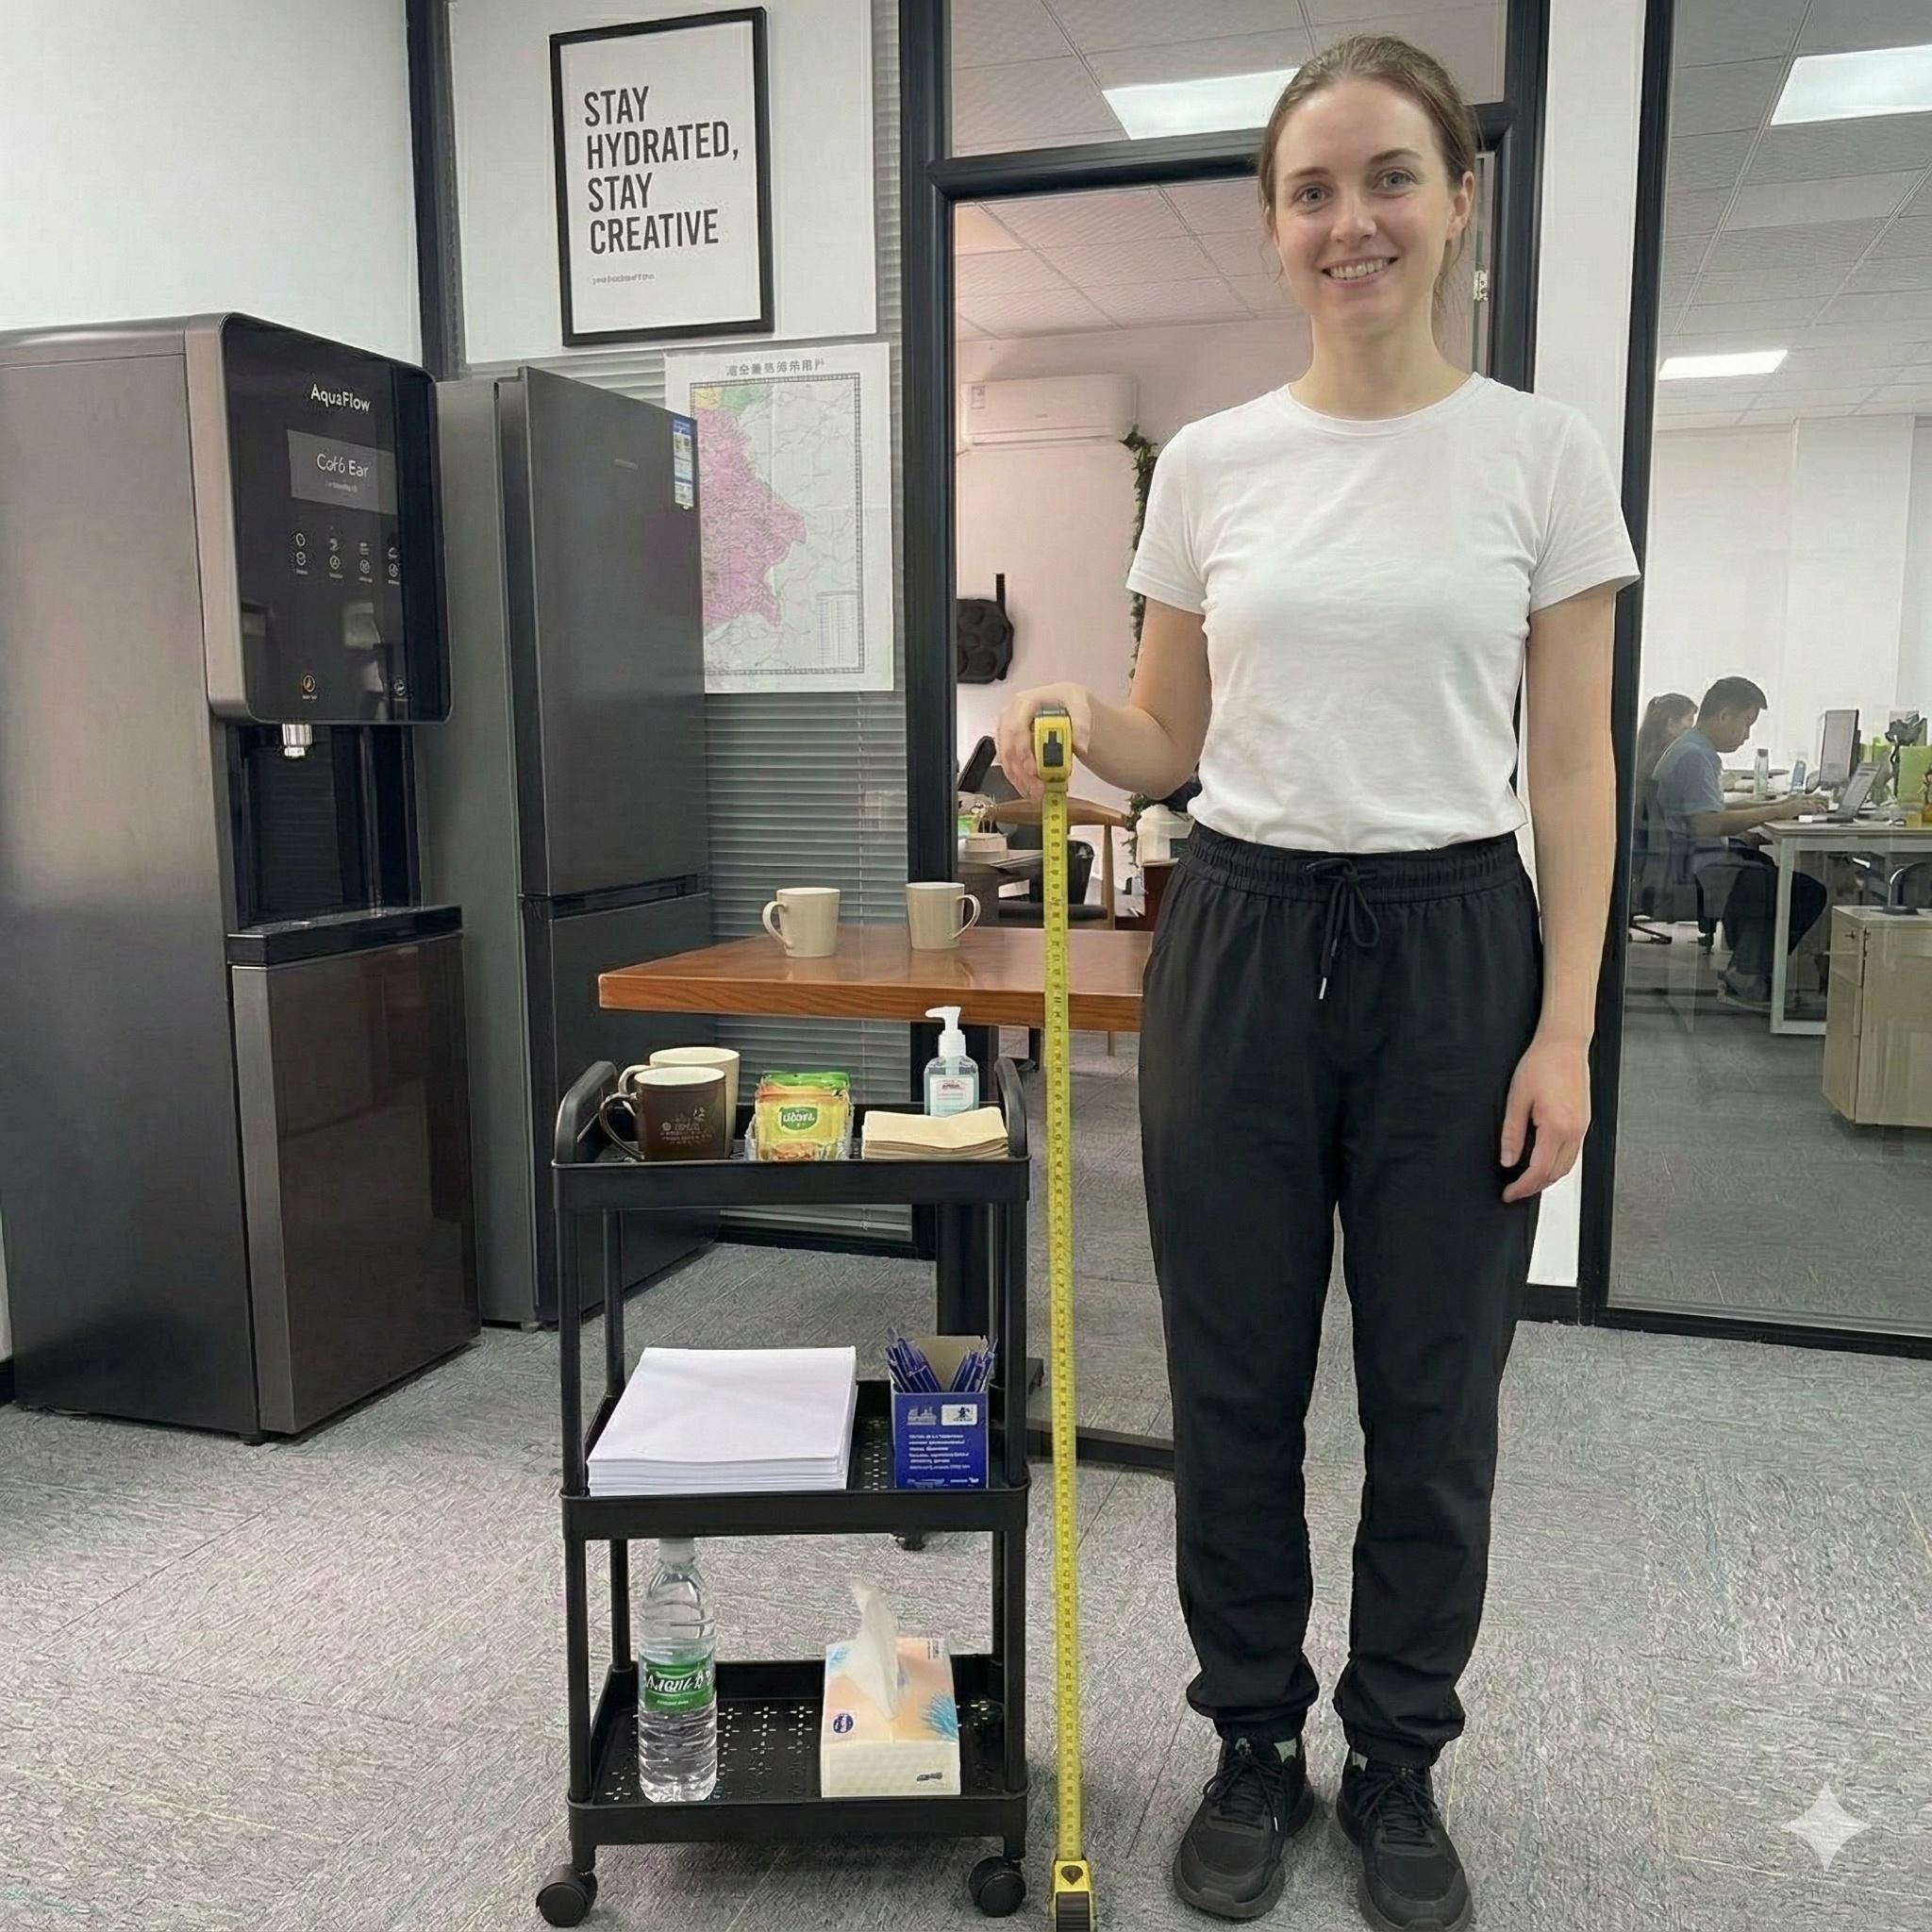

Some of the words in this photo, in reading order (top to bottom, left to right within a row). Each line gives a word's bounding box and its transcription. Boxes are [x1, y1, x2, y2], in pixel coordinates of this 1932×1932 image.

[584, 85, 650, 127] STAY
[586, 120, 739, 170] HYDRATED,
[588, 172, 653, 212] STAY
[590, 208, 719, 255] CREATIVE
[310, 384, 371, 412] AquaFlow
